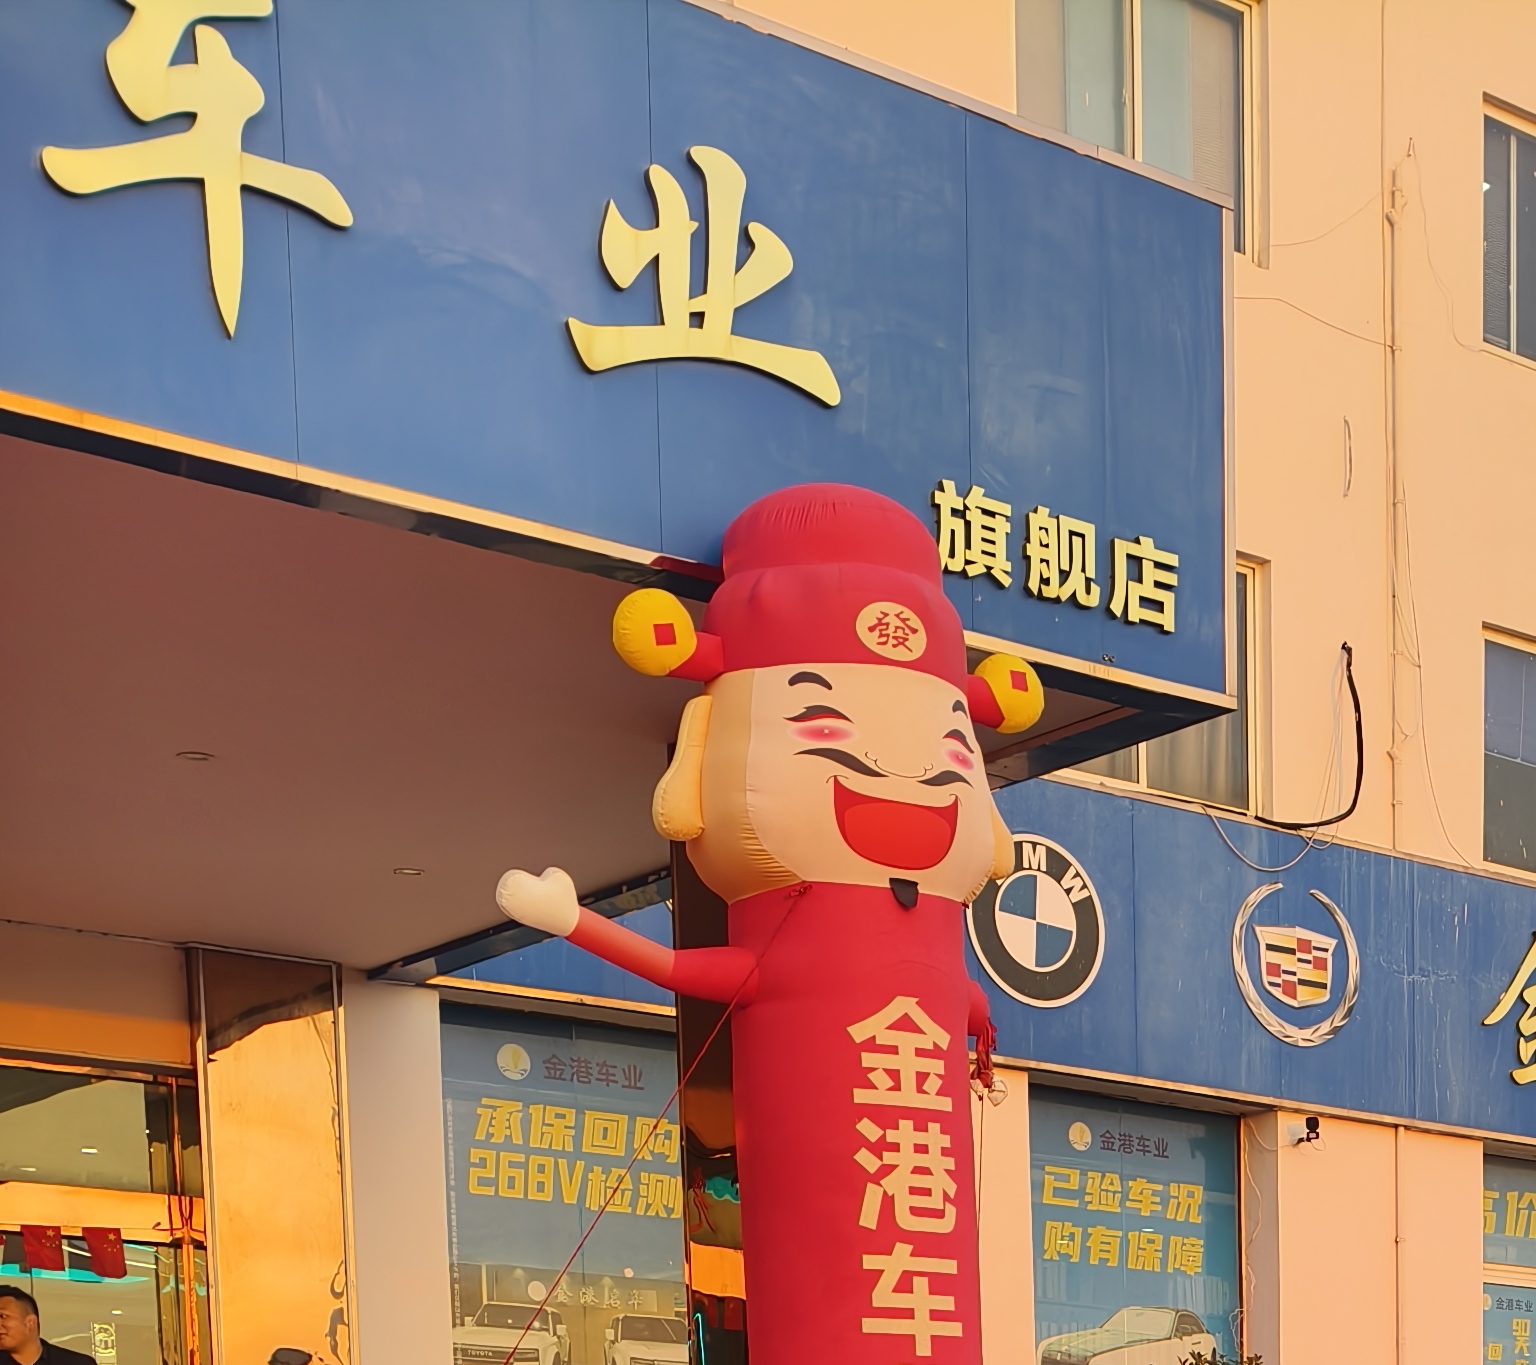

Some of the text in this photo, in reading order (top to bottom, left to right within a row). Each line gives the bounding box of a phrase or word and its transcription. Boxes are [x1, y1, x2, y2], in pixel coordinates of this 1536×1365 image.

[930, 478, 1180, 633] 旗舰店
[867, 610, 919, 654] 發
[542, 1054, 645, 1091] 金港车业
[474, 1097, 681, 1164] 承保回购
[1099, 1129, 1170, 1159] 金港车业
[468, 1148, 683, 1219] 268V检测
[1042, 1165, 1204, 1224] 已验车况
[1043, 1220, 1204, 1276] 购有保障
[1495, 1297, 1534, 1312] 金港车业
